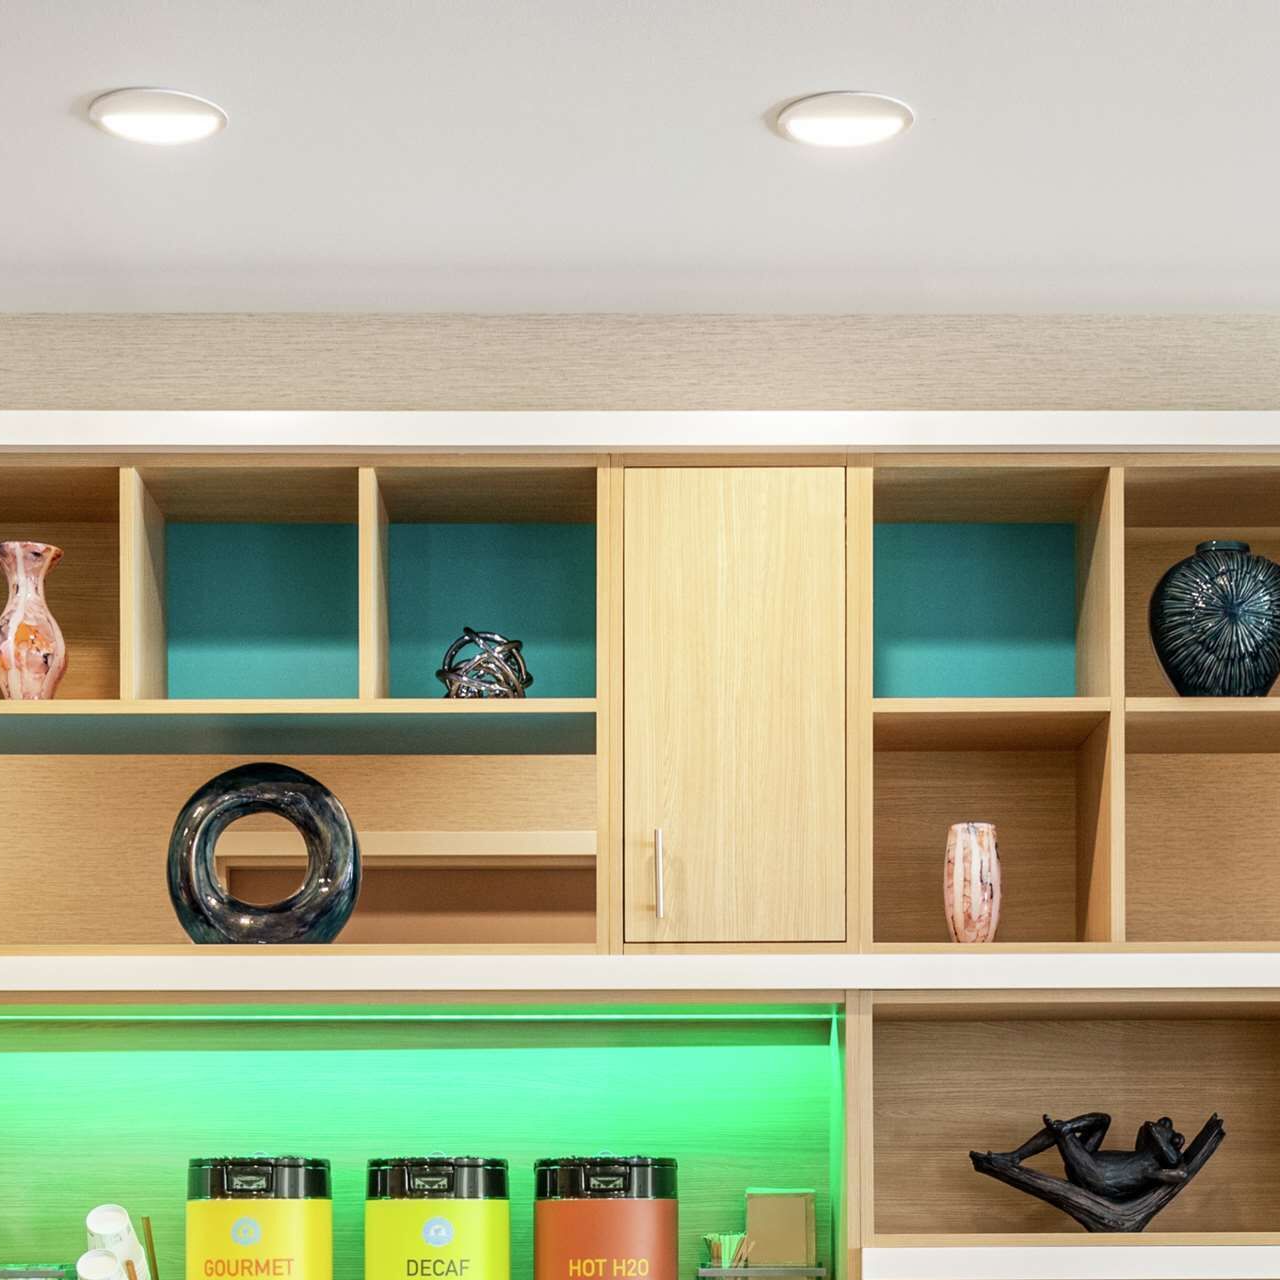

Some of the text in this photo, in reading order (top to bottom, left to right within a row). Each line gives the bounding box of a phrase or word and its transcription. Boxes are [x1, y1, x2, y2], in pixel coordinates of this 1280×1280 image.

[204, 1258, 295, 1278] GOURMET
[406, 1258, 471, 1277] DECAF
[568, 1258, 608, 1278] HOT
